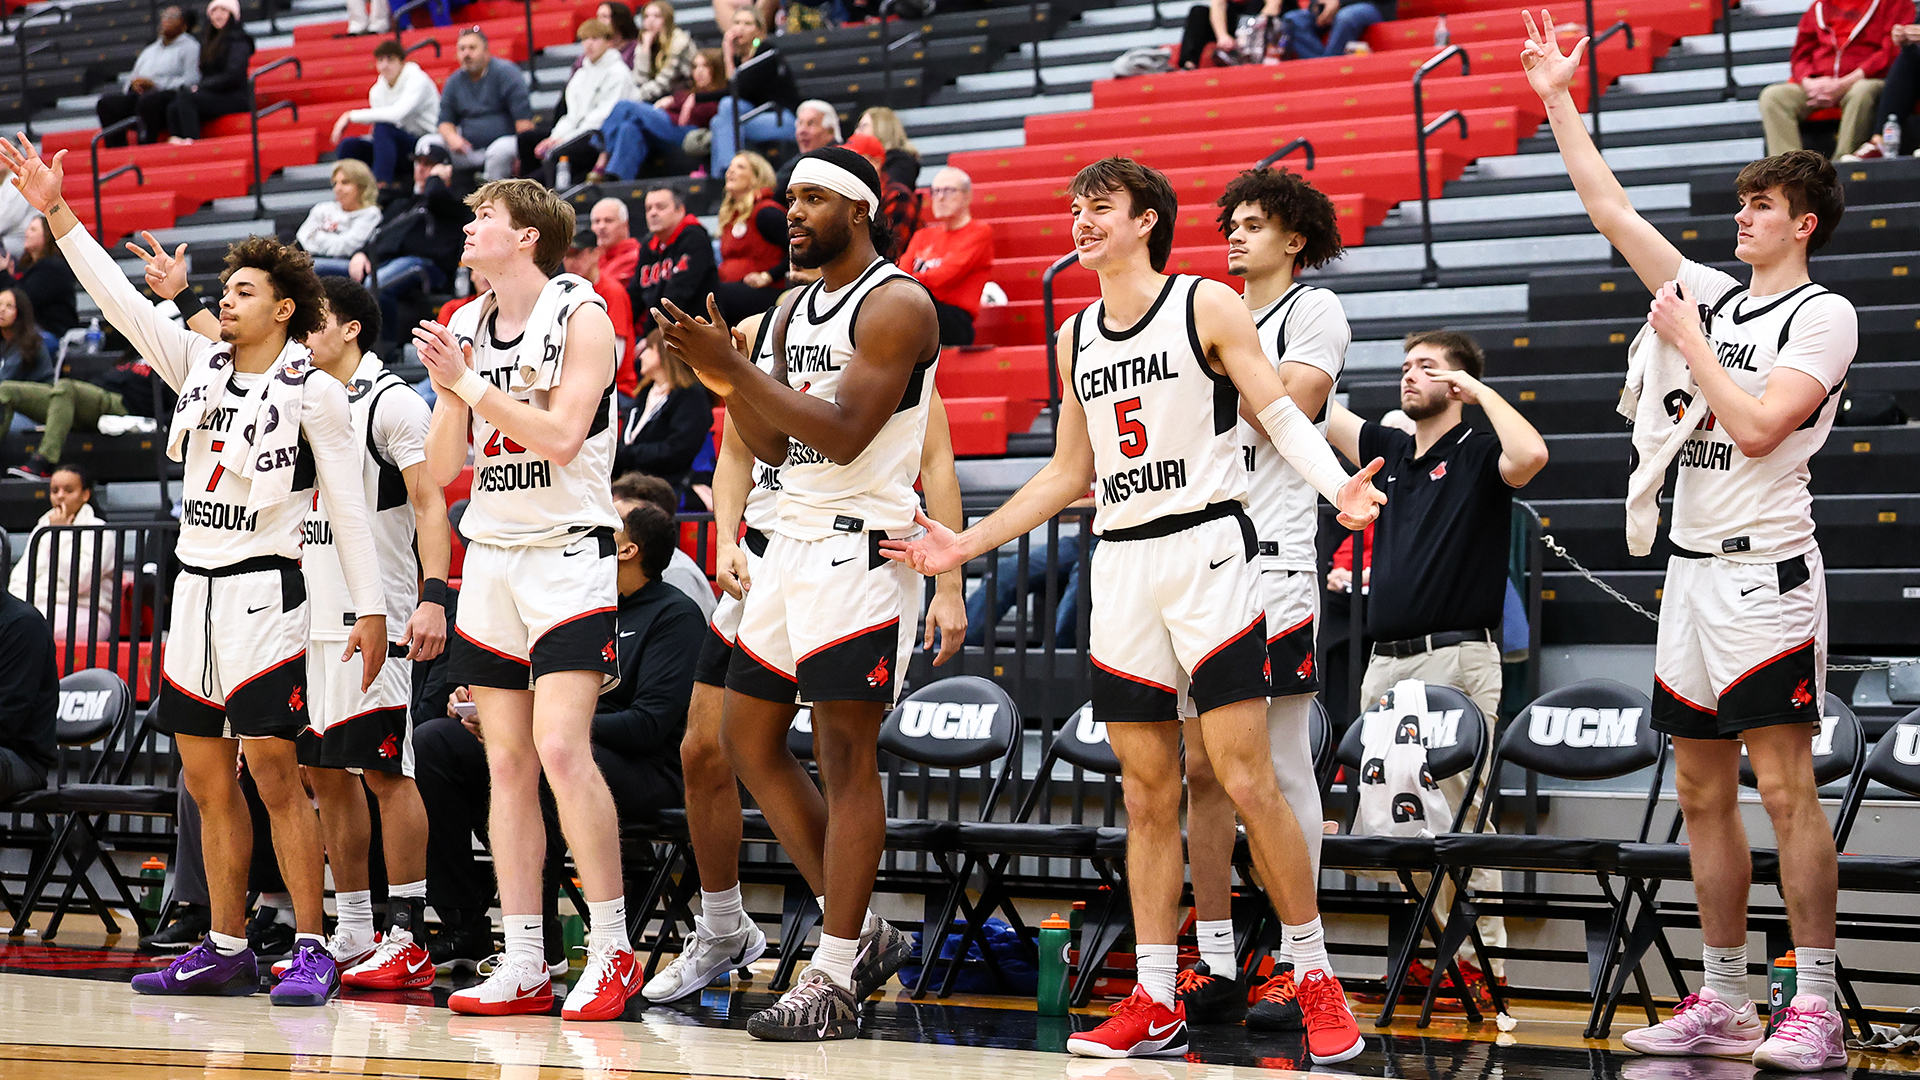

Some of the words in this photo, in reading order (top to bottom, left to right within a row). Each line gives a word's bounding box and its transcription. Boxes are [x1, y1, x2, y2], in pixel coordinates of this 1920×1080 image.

[1080, 351, 1179, 402] CENTRAL
[1113, 396, 1149, 459] 5
[1102, 458, 1187, 507] MISSOURI
[183, 499, 259, 533] MISSOURI
[898, 701, 1000, 740] UCM
[1528, 705, 1644, 749] UCM
